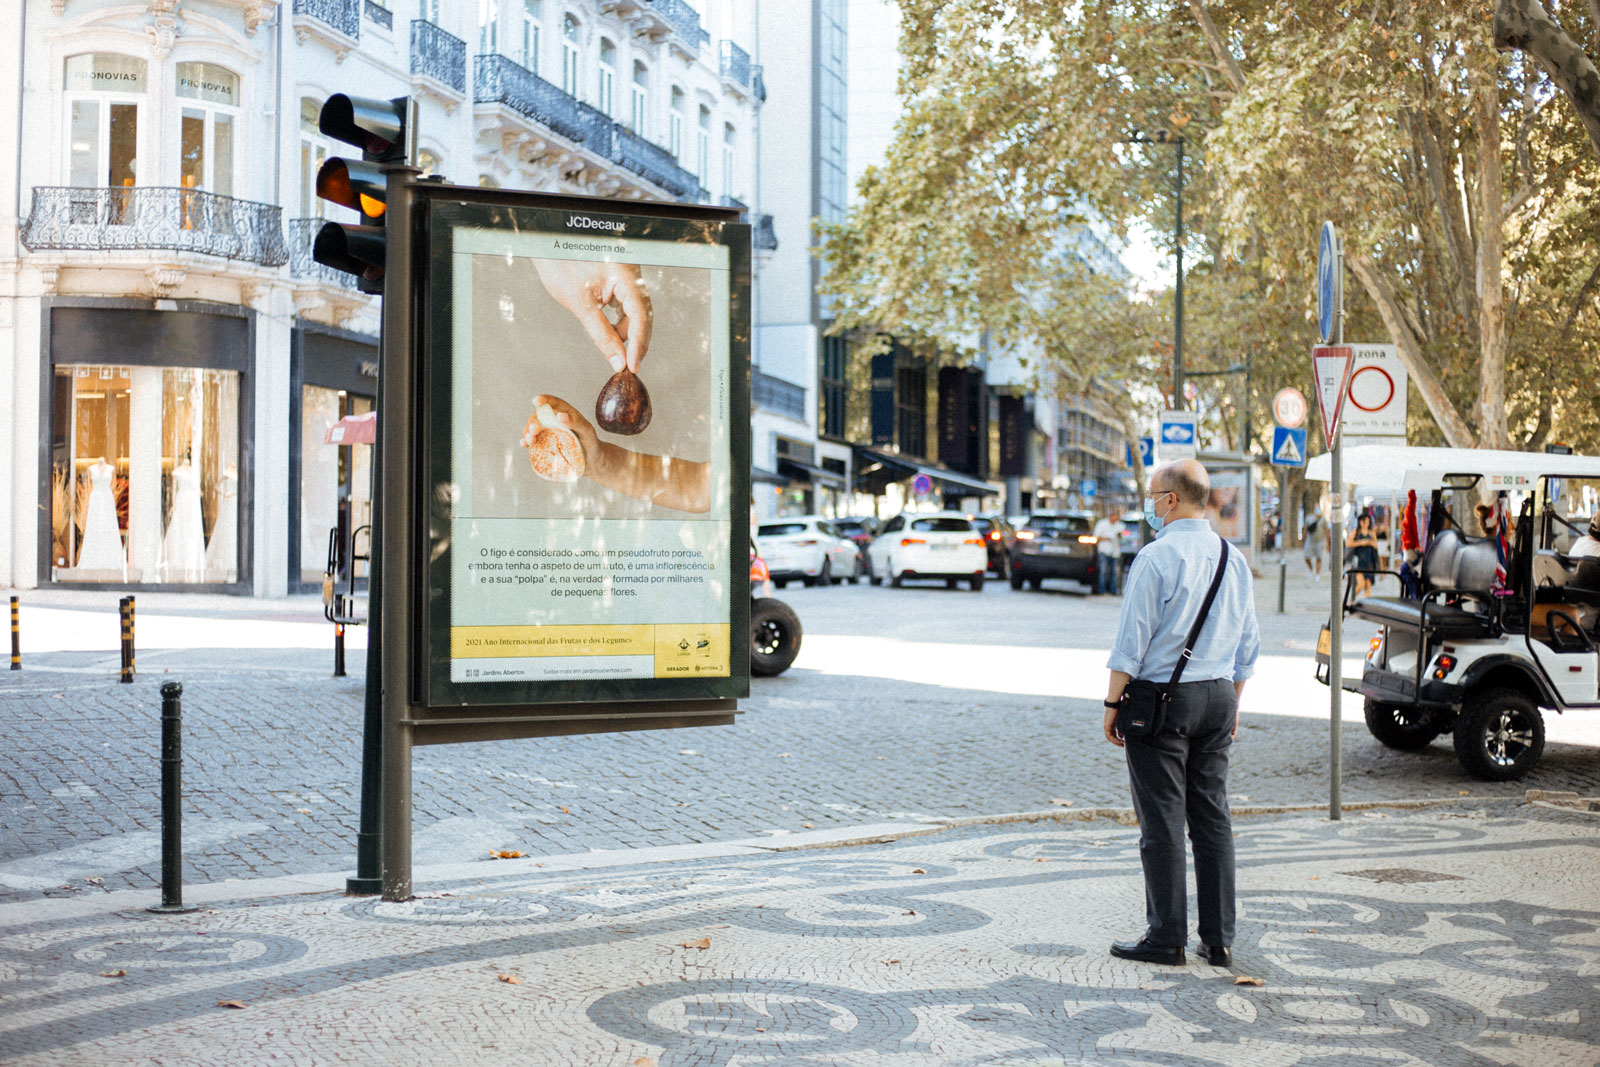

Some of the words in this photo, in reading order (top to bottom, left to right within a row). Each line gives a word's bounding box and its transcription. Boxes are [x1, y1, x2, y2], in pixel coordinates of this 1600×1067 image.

[75, 71, 137, 82] PRONOVIAS
[566, 216, 626, 231] JCDecaux
[553, 239, 561, 249] À
[562, 241, 612, 252] descoberta
[1358, 350, 1386, 359] zona
[480, 548, 488, 557] O
[490, 548, 507, 558] figo
[509, 548, 515, 557] é
[516, 548, 573, 557] considerado
[618, 549, 670, 558] pseudofruto
[671, 550, 704, 559] porque,
[468, 562, 503, 570] embora
[505, 562, 531, 570] tenha
[540, 562, 571, 571] aspeto
[573, 562, 585, 570] de
[627, 561, 633, 570] é
[655, 562, 715, 570] inflorescência
[549, 574, 558, 584] é,
[612, 575, 649, 583] formada
[650, 576, 665, 585] por
[666, 575, 704, 583] milhares
[551, 588, 563, 596] de
[564, 589, 609, 598] pequenas
[610, 588, 637, 596] flores.
[465, 638, 482, 646] 2021
[483, 638, 498, 646] Ano
[499, 637, 546, 646] Internacional
[546, 637, 559, 645] das
[560, 637, 582, 645] Frutas
[602, 637, 633, 645] Legumes
[583, 667, 633, 675] jardinsabertos.com
